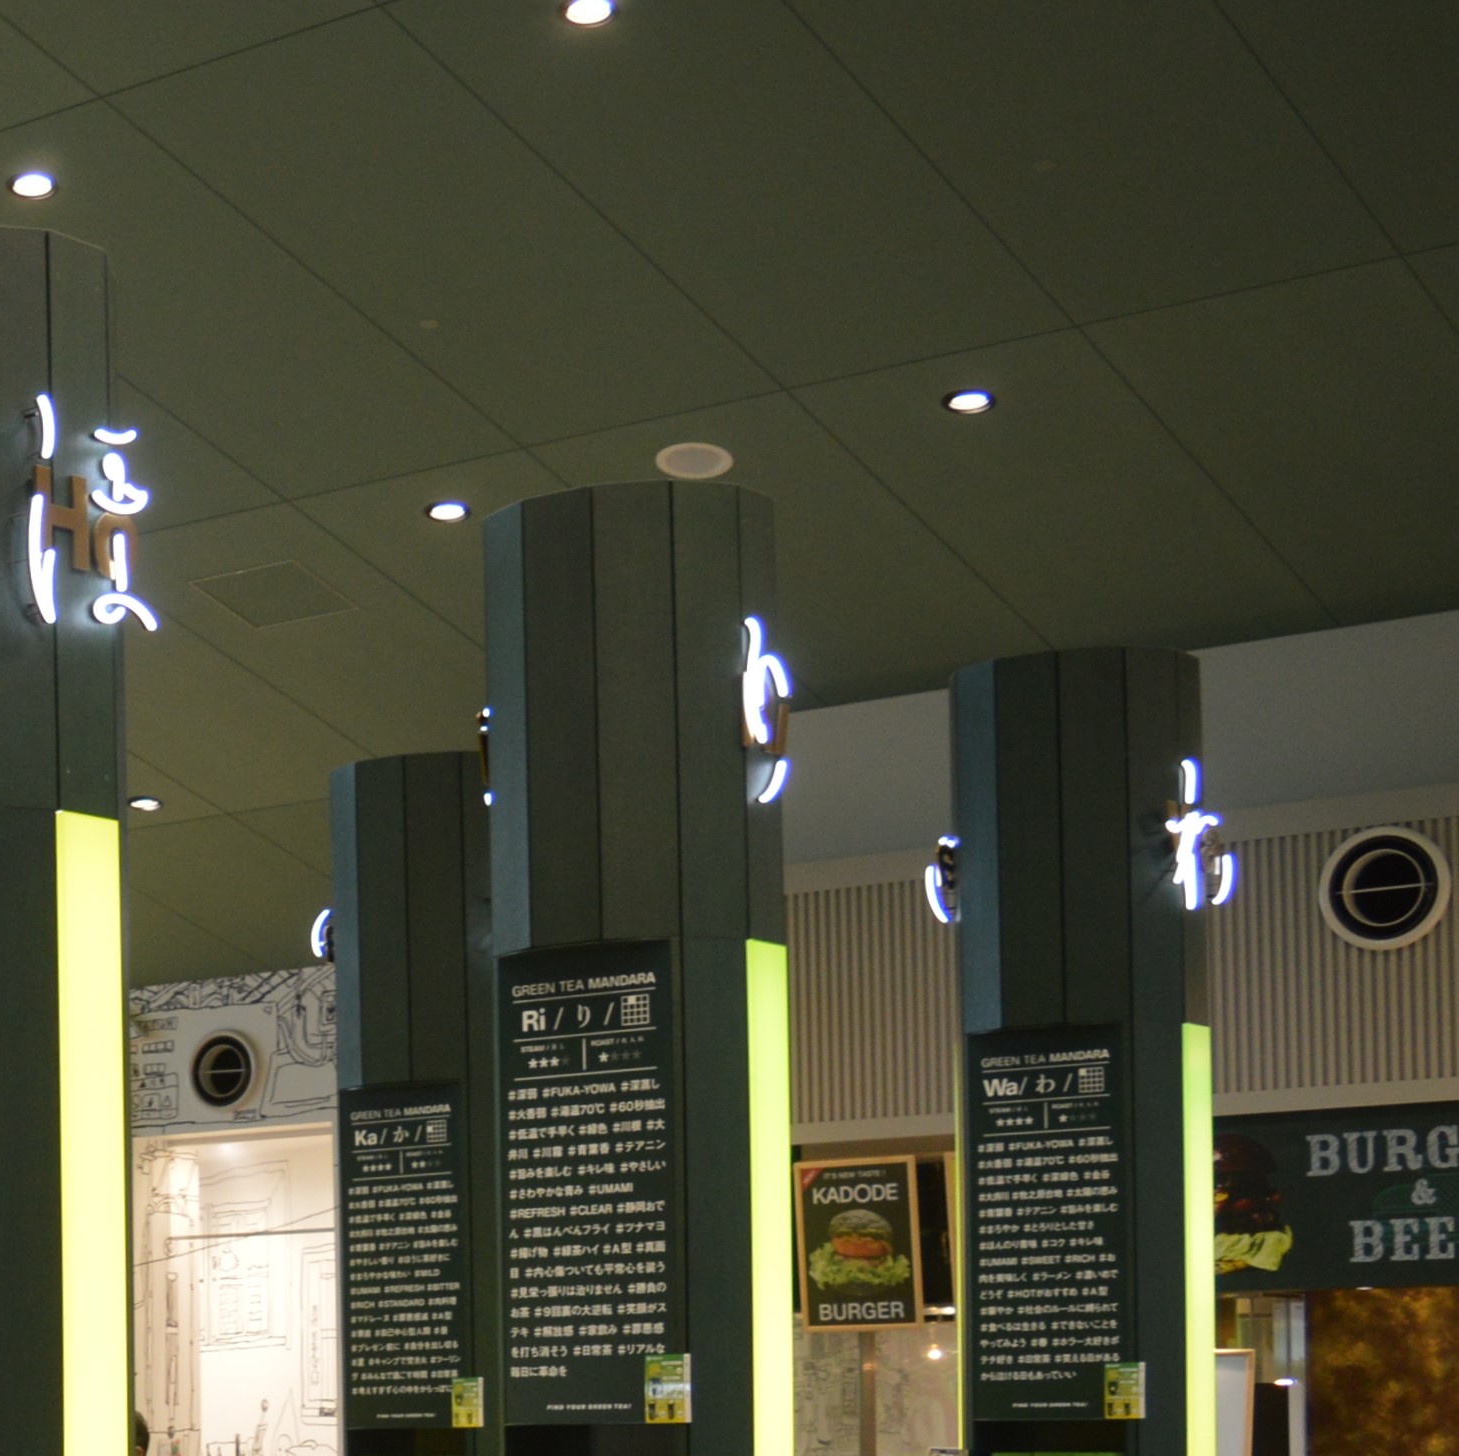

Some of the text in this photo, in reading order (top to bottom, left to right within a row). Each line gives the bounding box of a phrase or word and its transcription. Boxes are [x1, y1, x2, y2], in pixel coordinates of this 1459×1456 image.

[28, 393, 159, 631] ほ
[31, 464, 140, 581] Ho
[511, 971, 656, 998] GREEN TEA MANDARA
[811, 1183, 900, 1205] KADODE
[1410, 1178, 1437, 1206] &
[818, 1301, 906, 1322] BURGER
